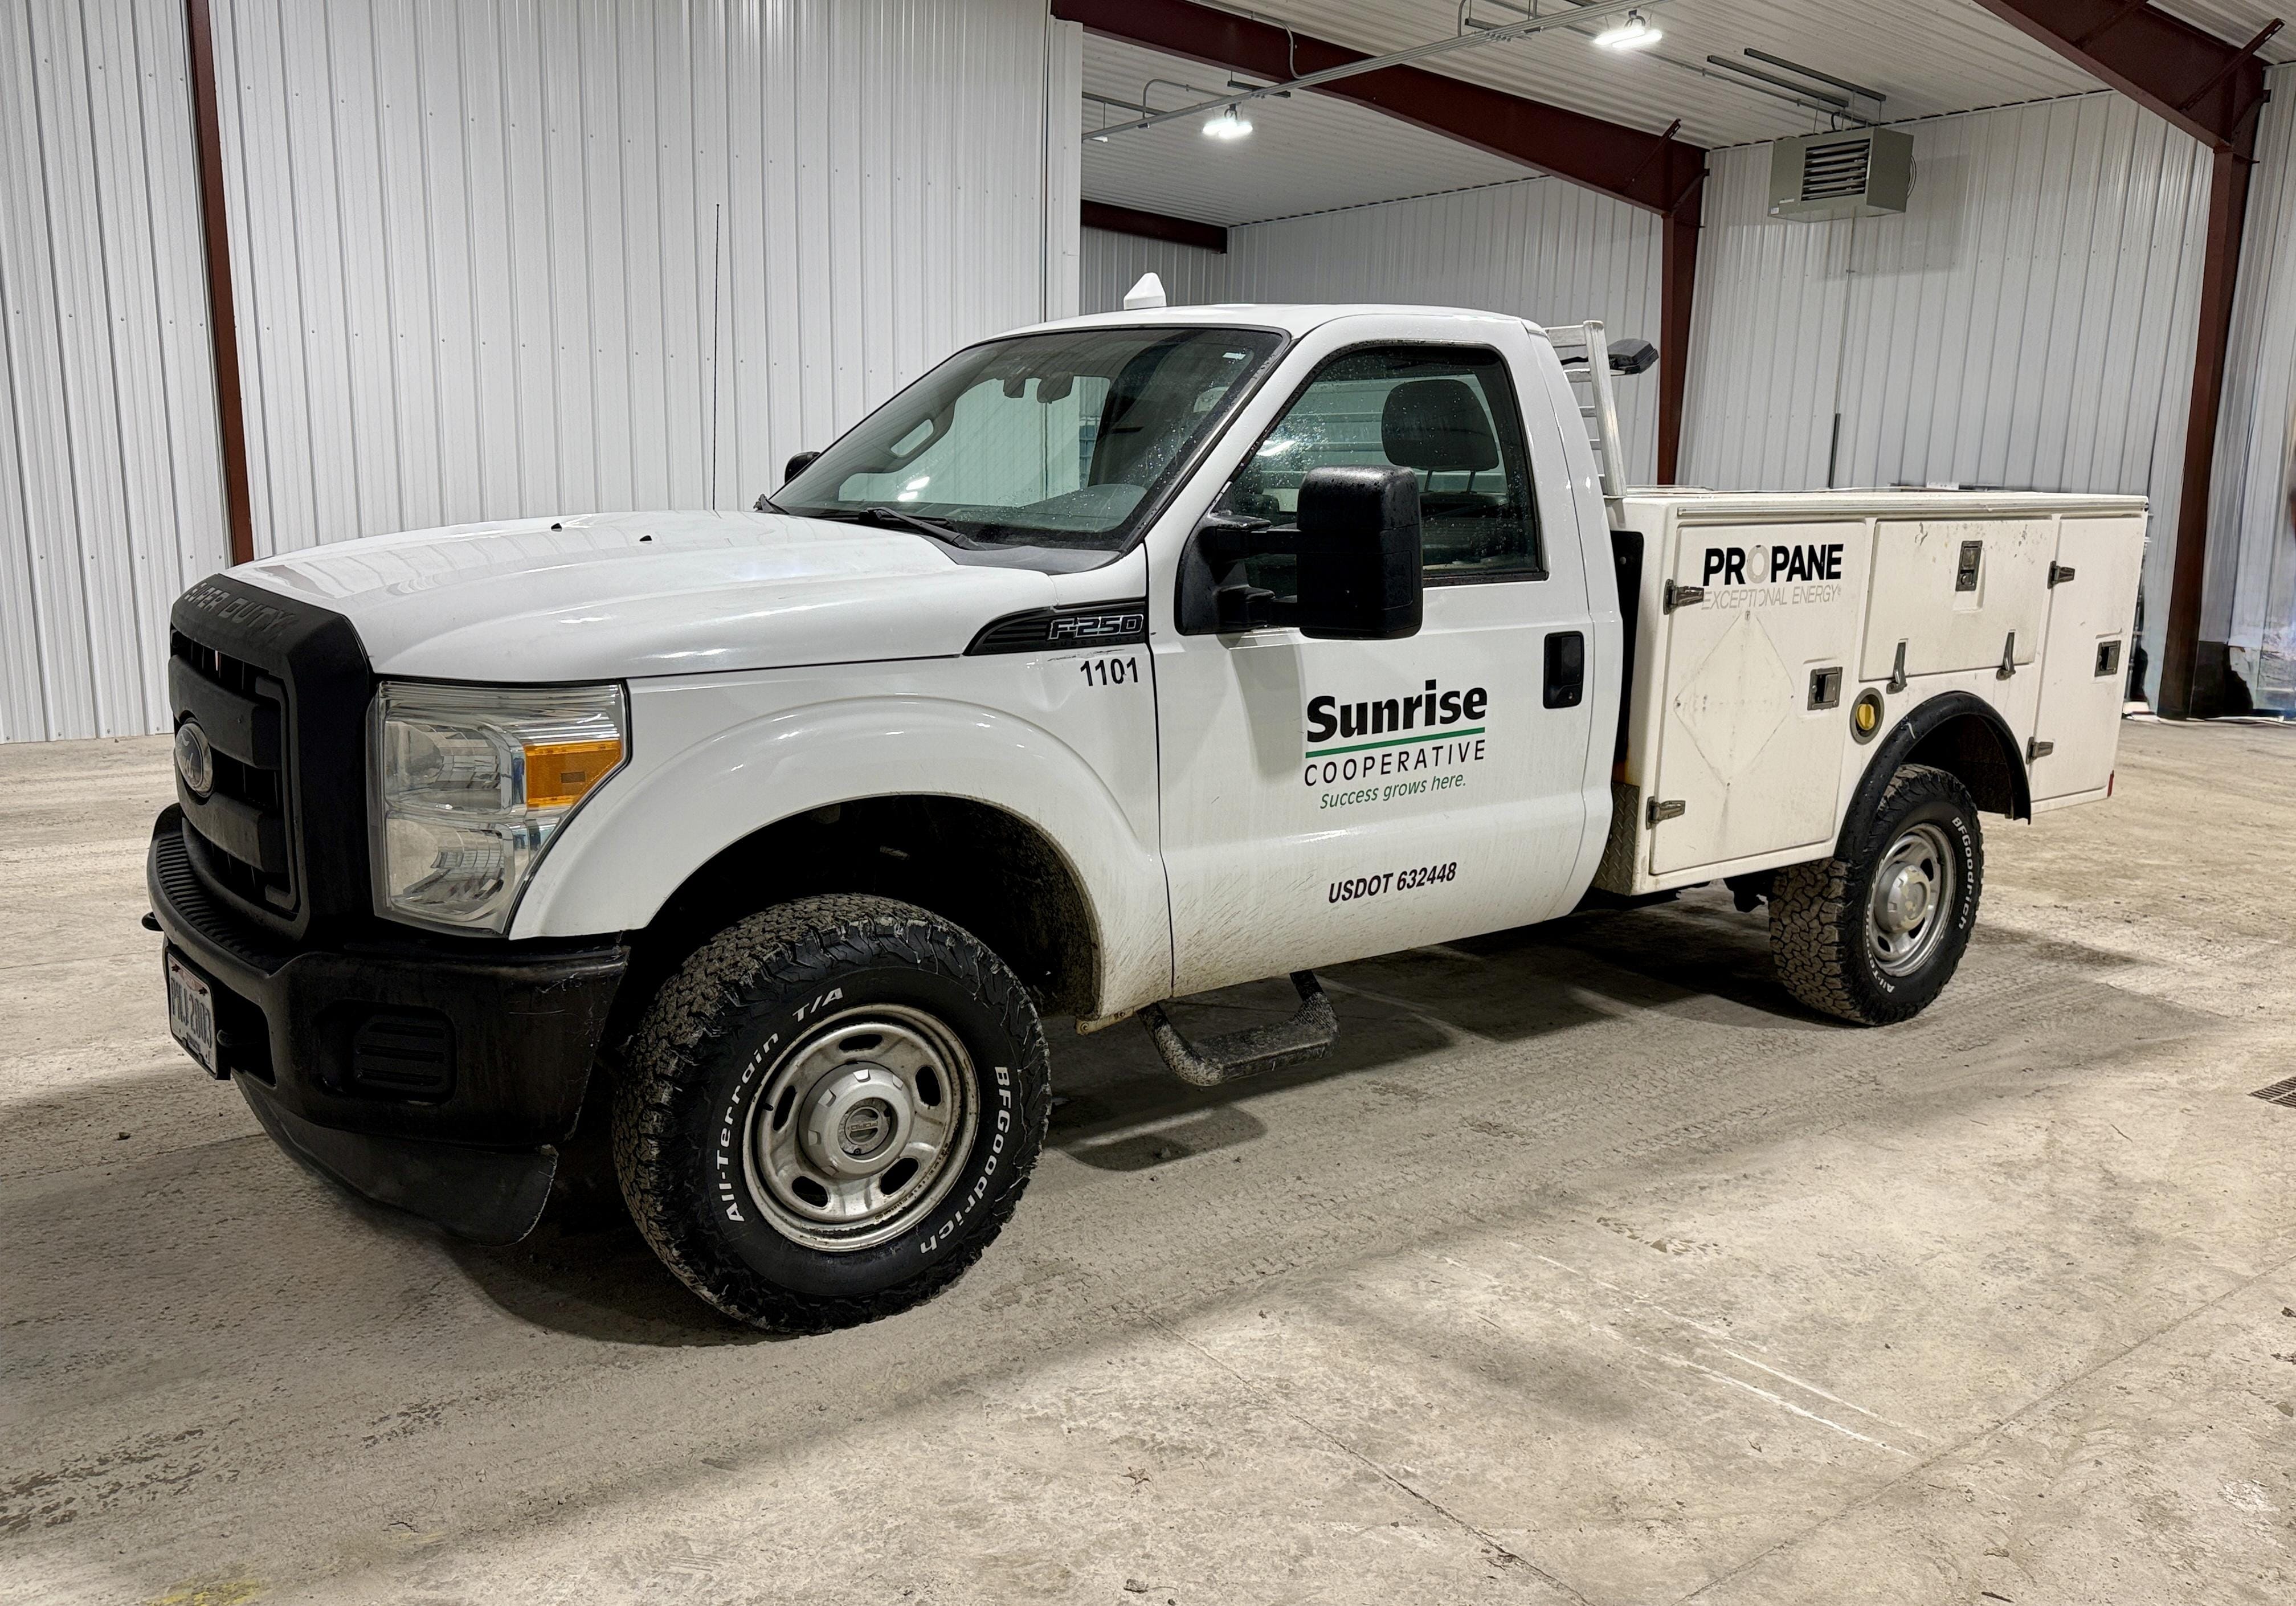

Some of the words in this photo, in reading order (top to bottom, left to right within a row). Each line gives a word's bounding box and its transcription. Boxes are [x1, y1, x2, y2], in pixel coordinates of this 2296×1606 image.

[1703, 543, 1844, 586] PROPANE
[218, 598, 295, 632] DUTY
[1047, 614, 1143, 640] F-250
[1080, 657, 1138, 686] 1101
[1307, 679, 1488, 742] Sunrise
[1305, 739, 1486, 786] COOPERATIVE
[1320, 787, 1379, 809] Success
[1383, 777, 1428, 801] grows
[1431, 774, 1466, 791] here.
[1329, 873, 1394, 904] USDOT
[1396, 862, 1457, 890] 632448
[1952, 817, 1974, 930] BFGoodrich
[792, 987, 843, 1023] T/A
[920, 1066, 1012, 1253] BFGoodrich
